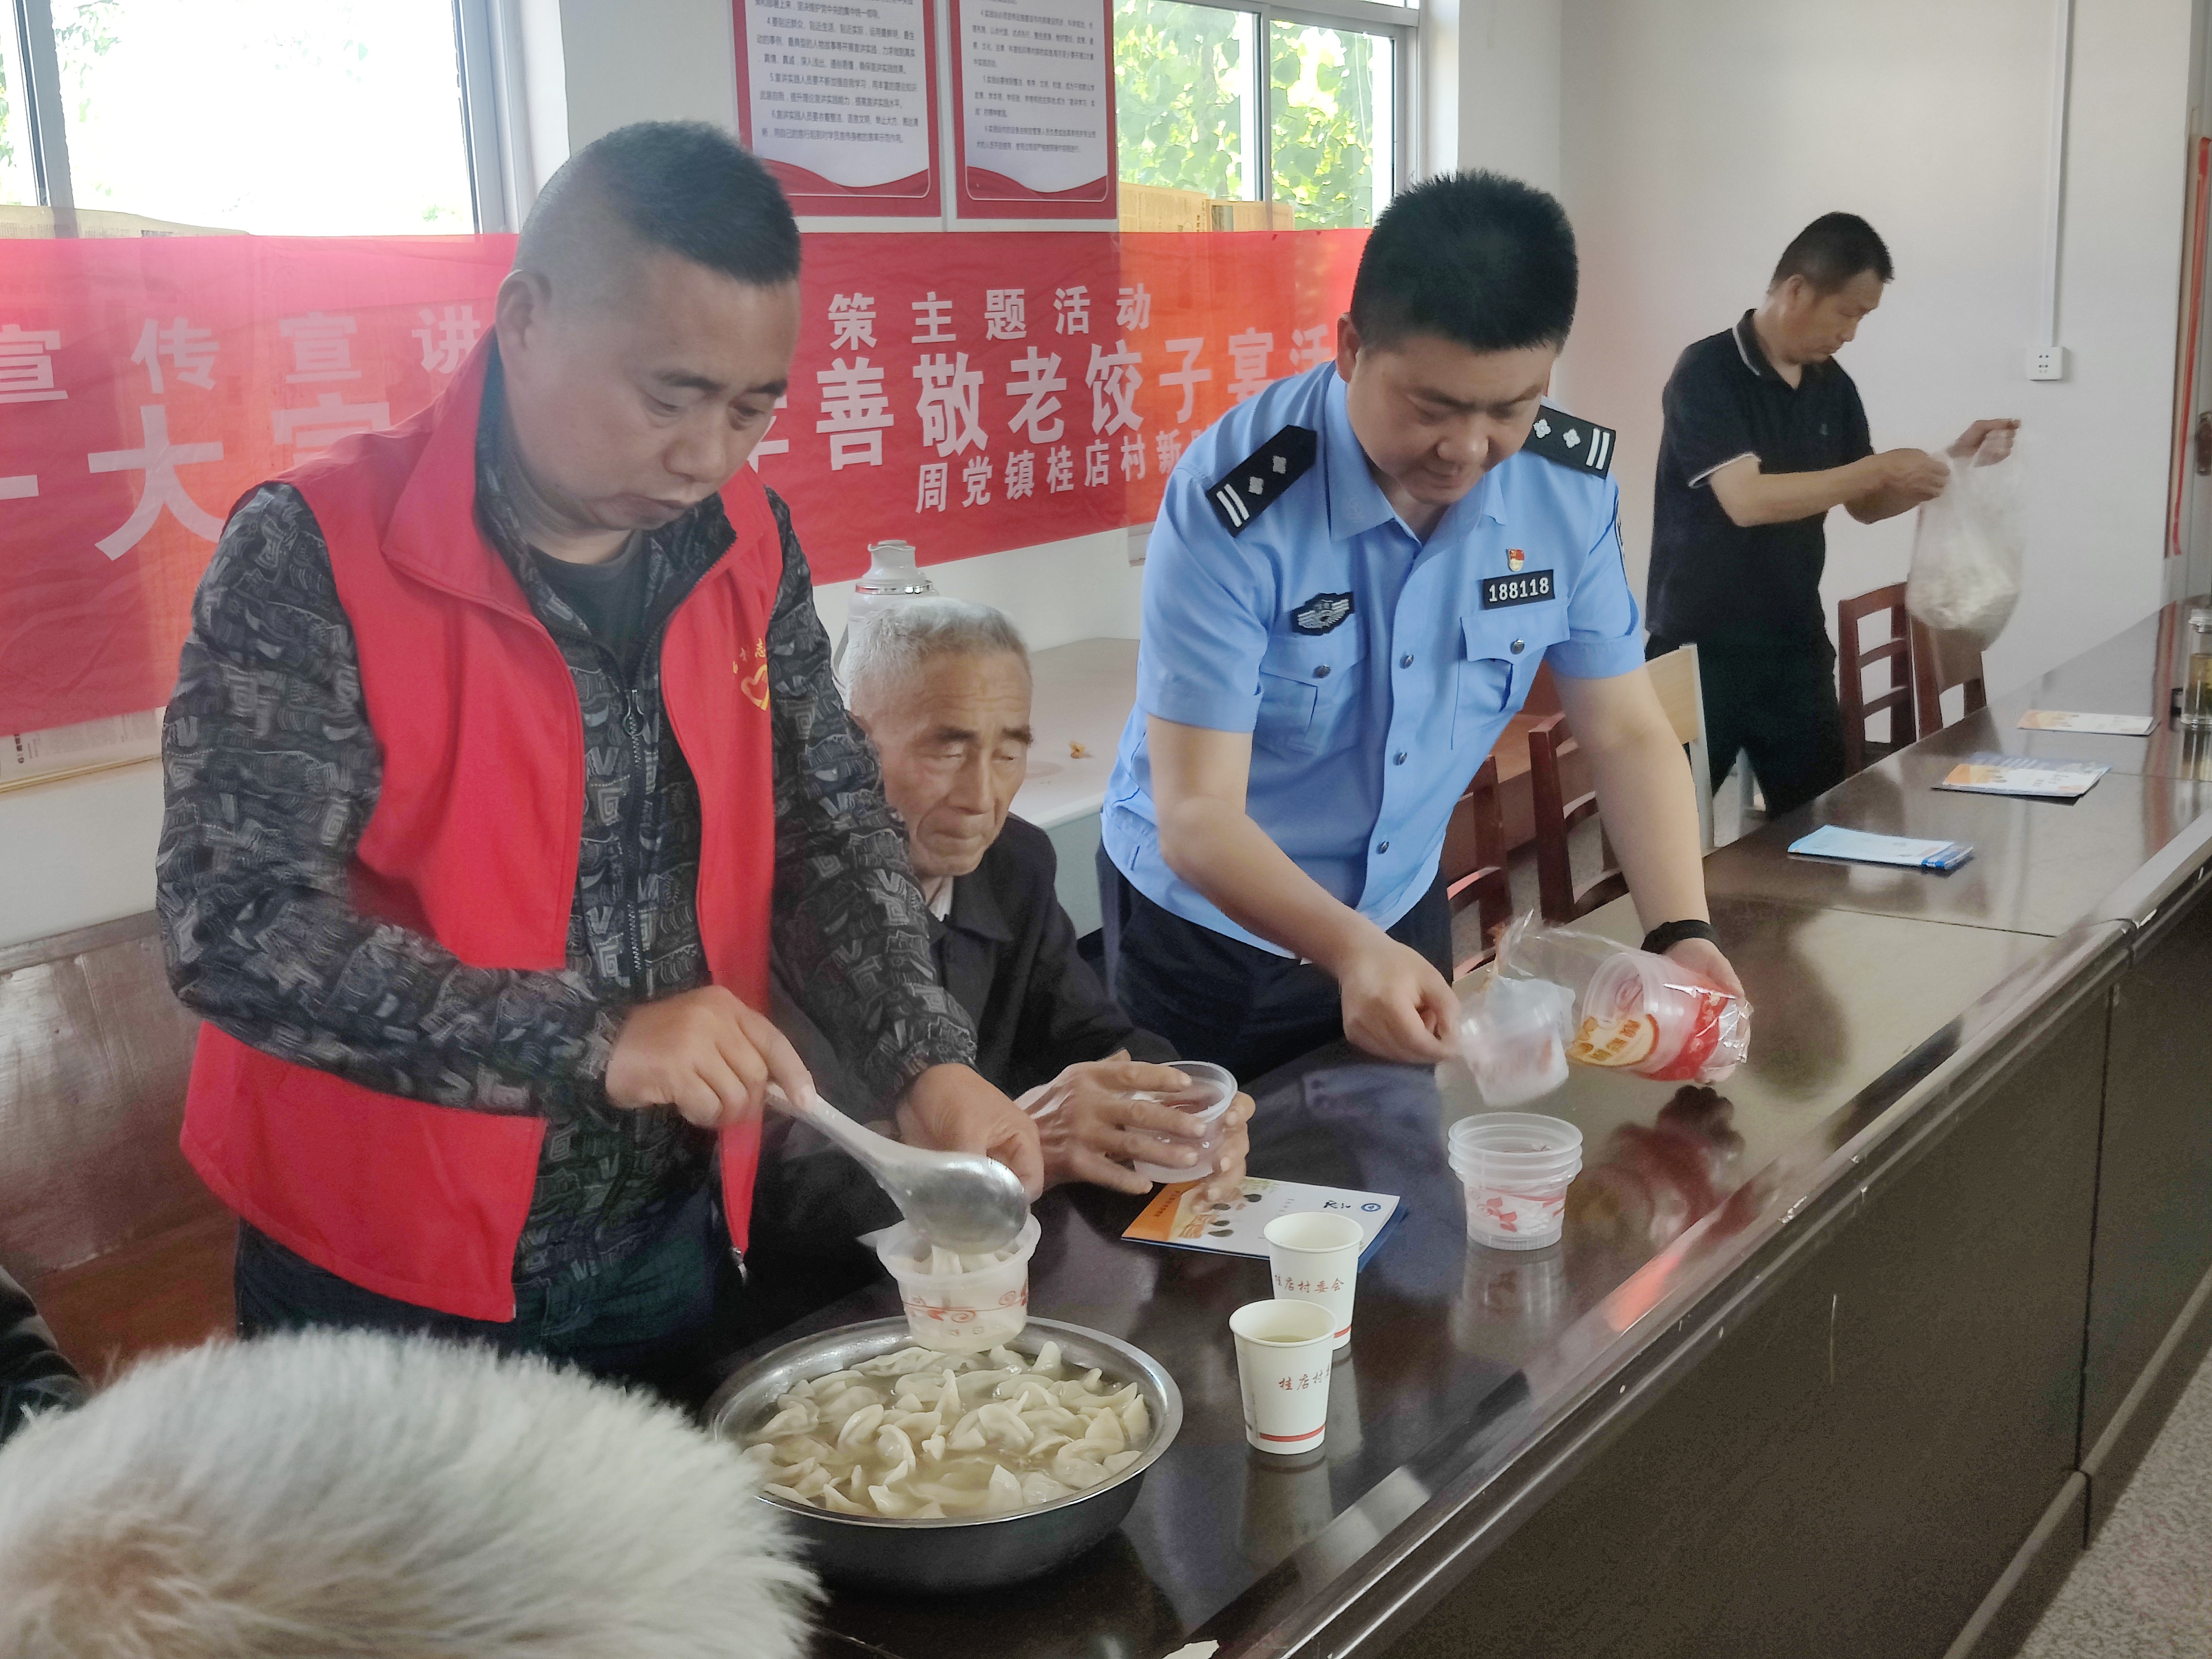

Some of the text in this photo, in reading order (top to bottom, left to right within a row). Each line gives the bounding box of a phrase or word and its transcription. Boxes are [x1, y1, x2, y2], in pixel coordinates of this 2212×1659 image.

[828, 283, 1151, 351] 策主题活动
[915, 428, 1201, 513] 周党镇桂店村新
[1489, 576, 1550, 602] 188118
